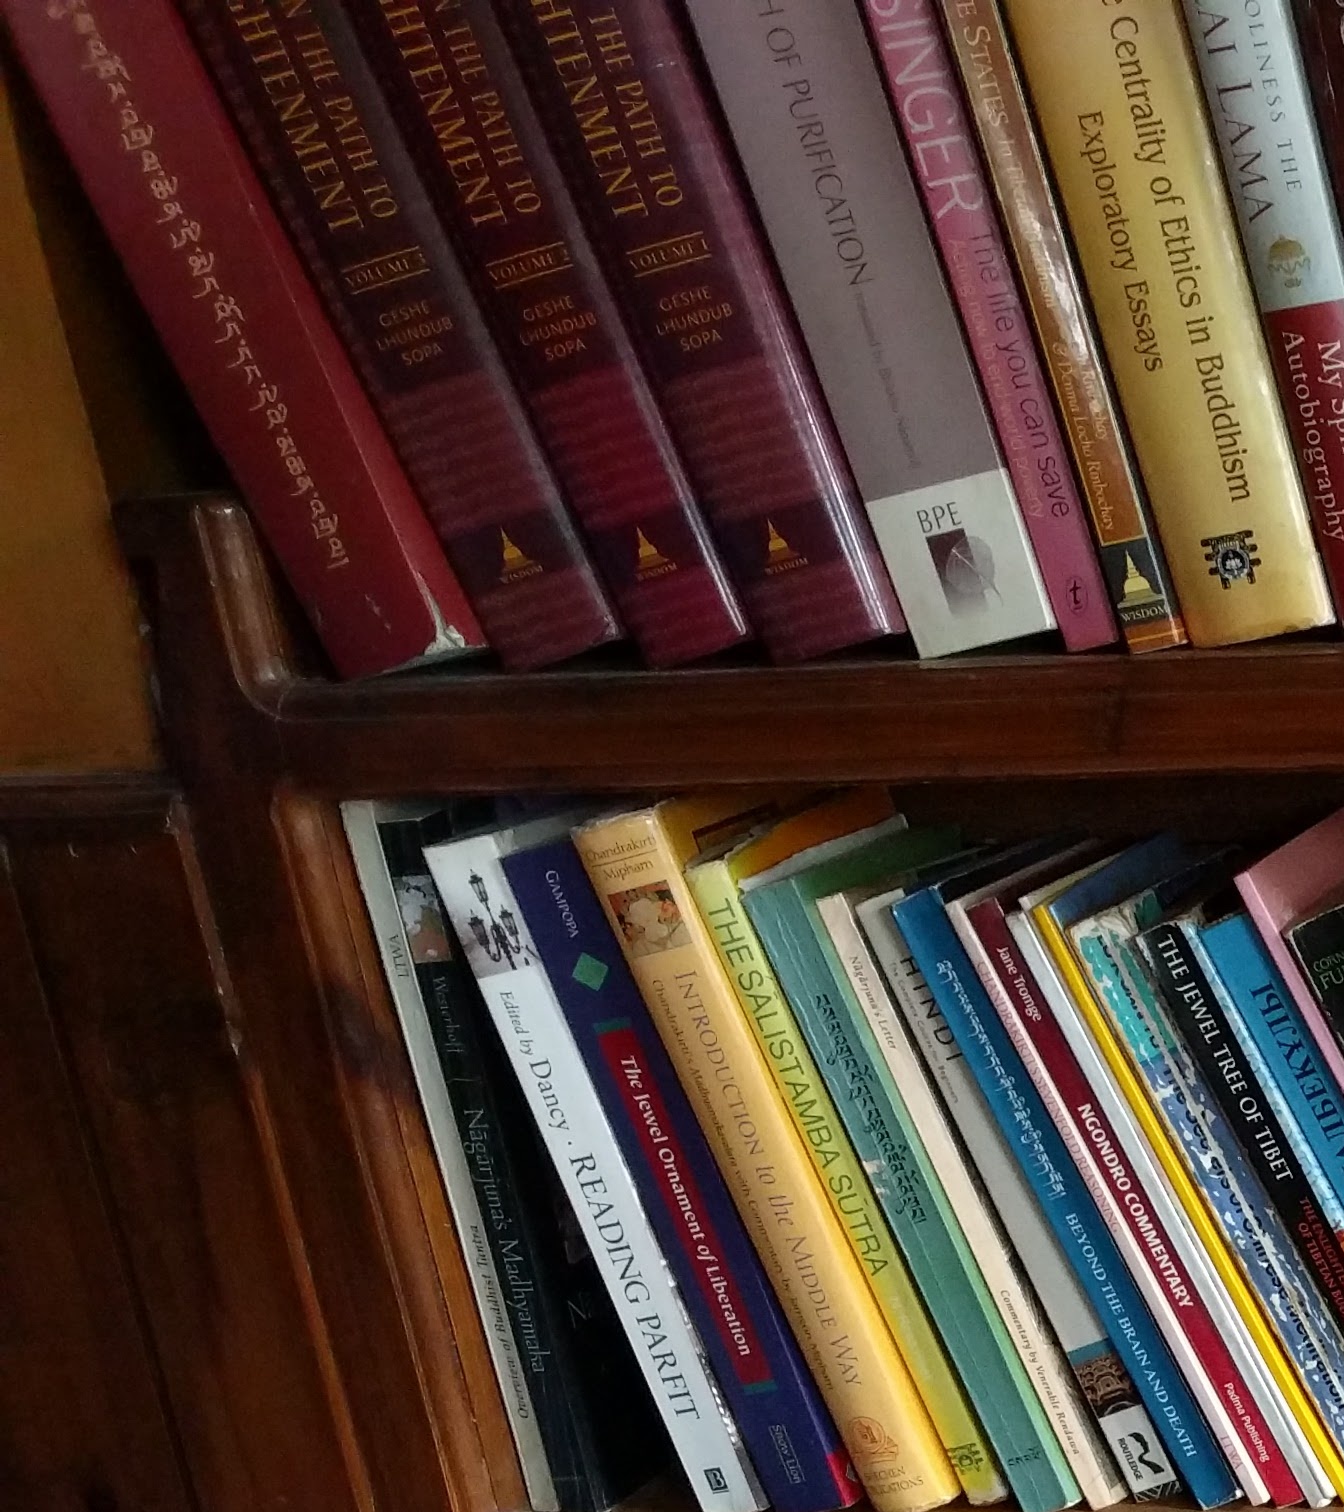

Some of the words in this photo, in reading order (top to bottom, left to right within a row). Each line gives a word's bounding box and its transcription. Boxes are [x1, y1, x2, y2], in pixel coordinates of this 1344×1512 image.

[1108, 15, 1166, 168] Centrality
[1218, 89, 1273, 222] LAMA
[1078, 110, 1138, 272] Exploratory
[1123, 280, 1164, 373] Essays
[1150, 175, 1186, 208] of
[1160, 216, 1201, 309] Ethics
[1186, 316, 1215, 347] in
[1316, 339, 1344, 390] My
[1195, 353, 1252, 503] Buddhism
[545, 870, 579, 938] GAMPOPA
[499, 991, 530, 1036] Edited
[519, 1038, 534, 1056] by
[530, 1057, 570, 1132] Dancy
[569, 1151, 652, 1305] READING
[636, 1311, 700, 1420] PARFIT
[620, 1055, 644, 1083] The
[634, 1085, 662, 1142] Jewel
[657, 1144, 703, 1239] Ornament
[695, 1242, 715, 1264] of
[705, 1264, 751, 1357] Liberation
[1078, 1103, 1131, 1192] NGONDRO
[1124, 1191, 1194, 1308] COMMENTARY
[1117, 1438, 1143, 1481] ROUTLEDGE
